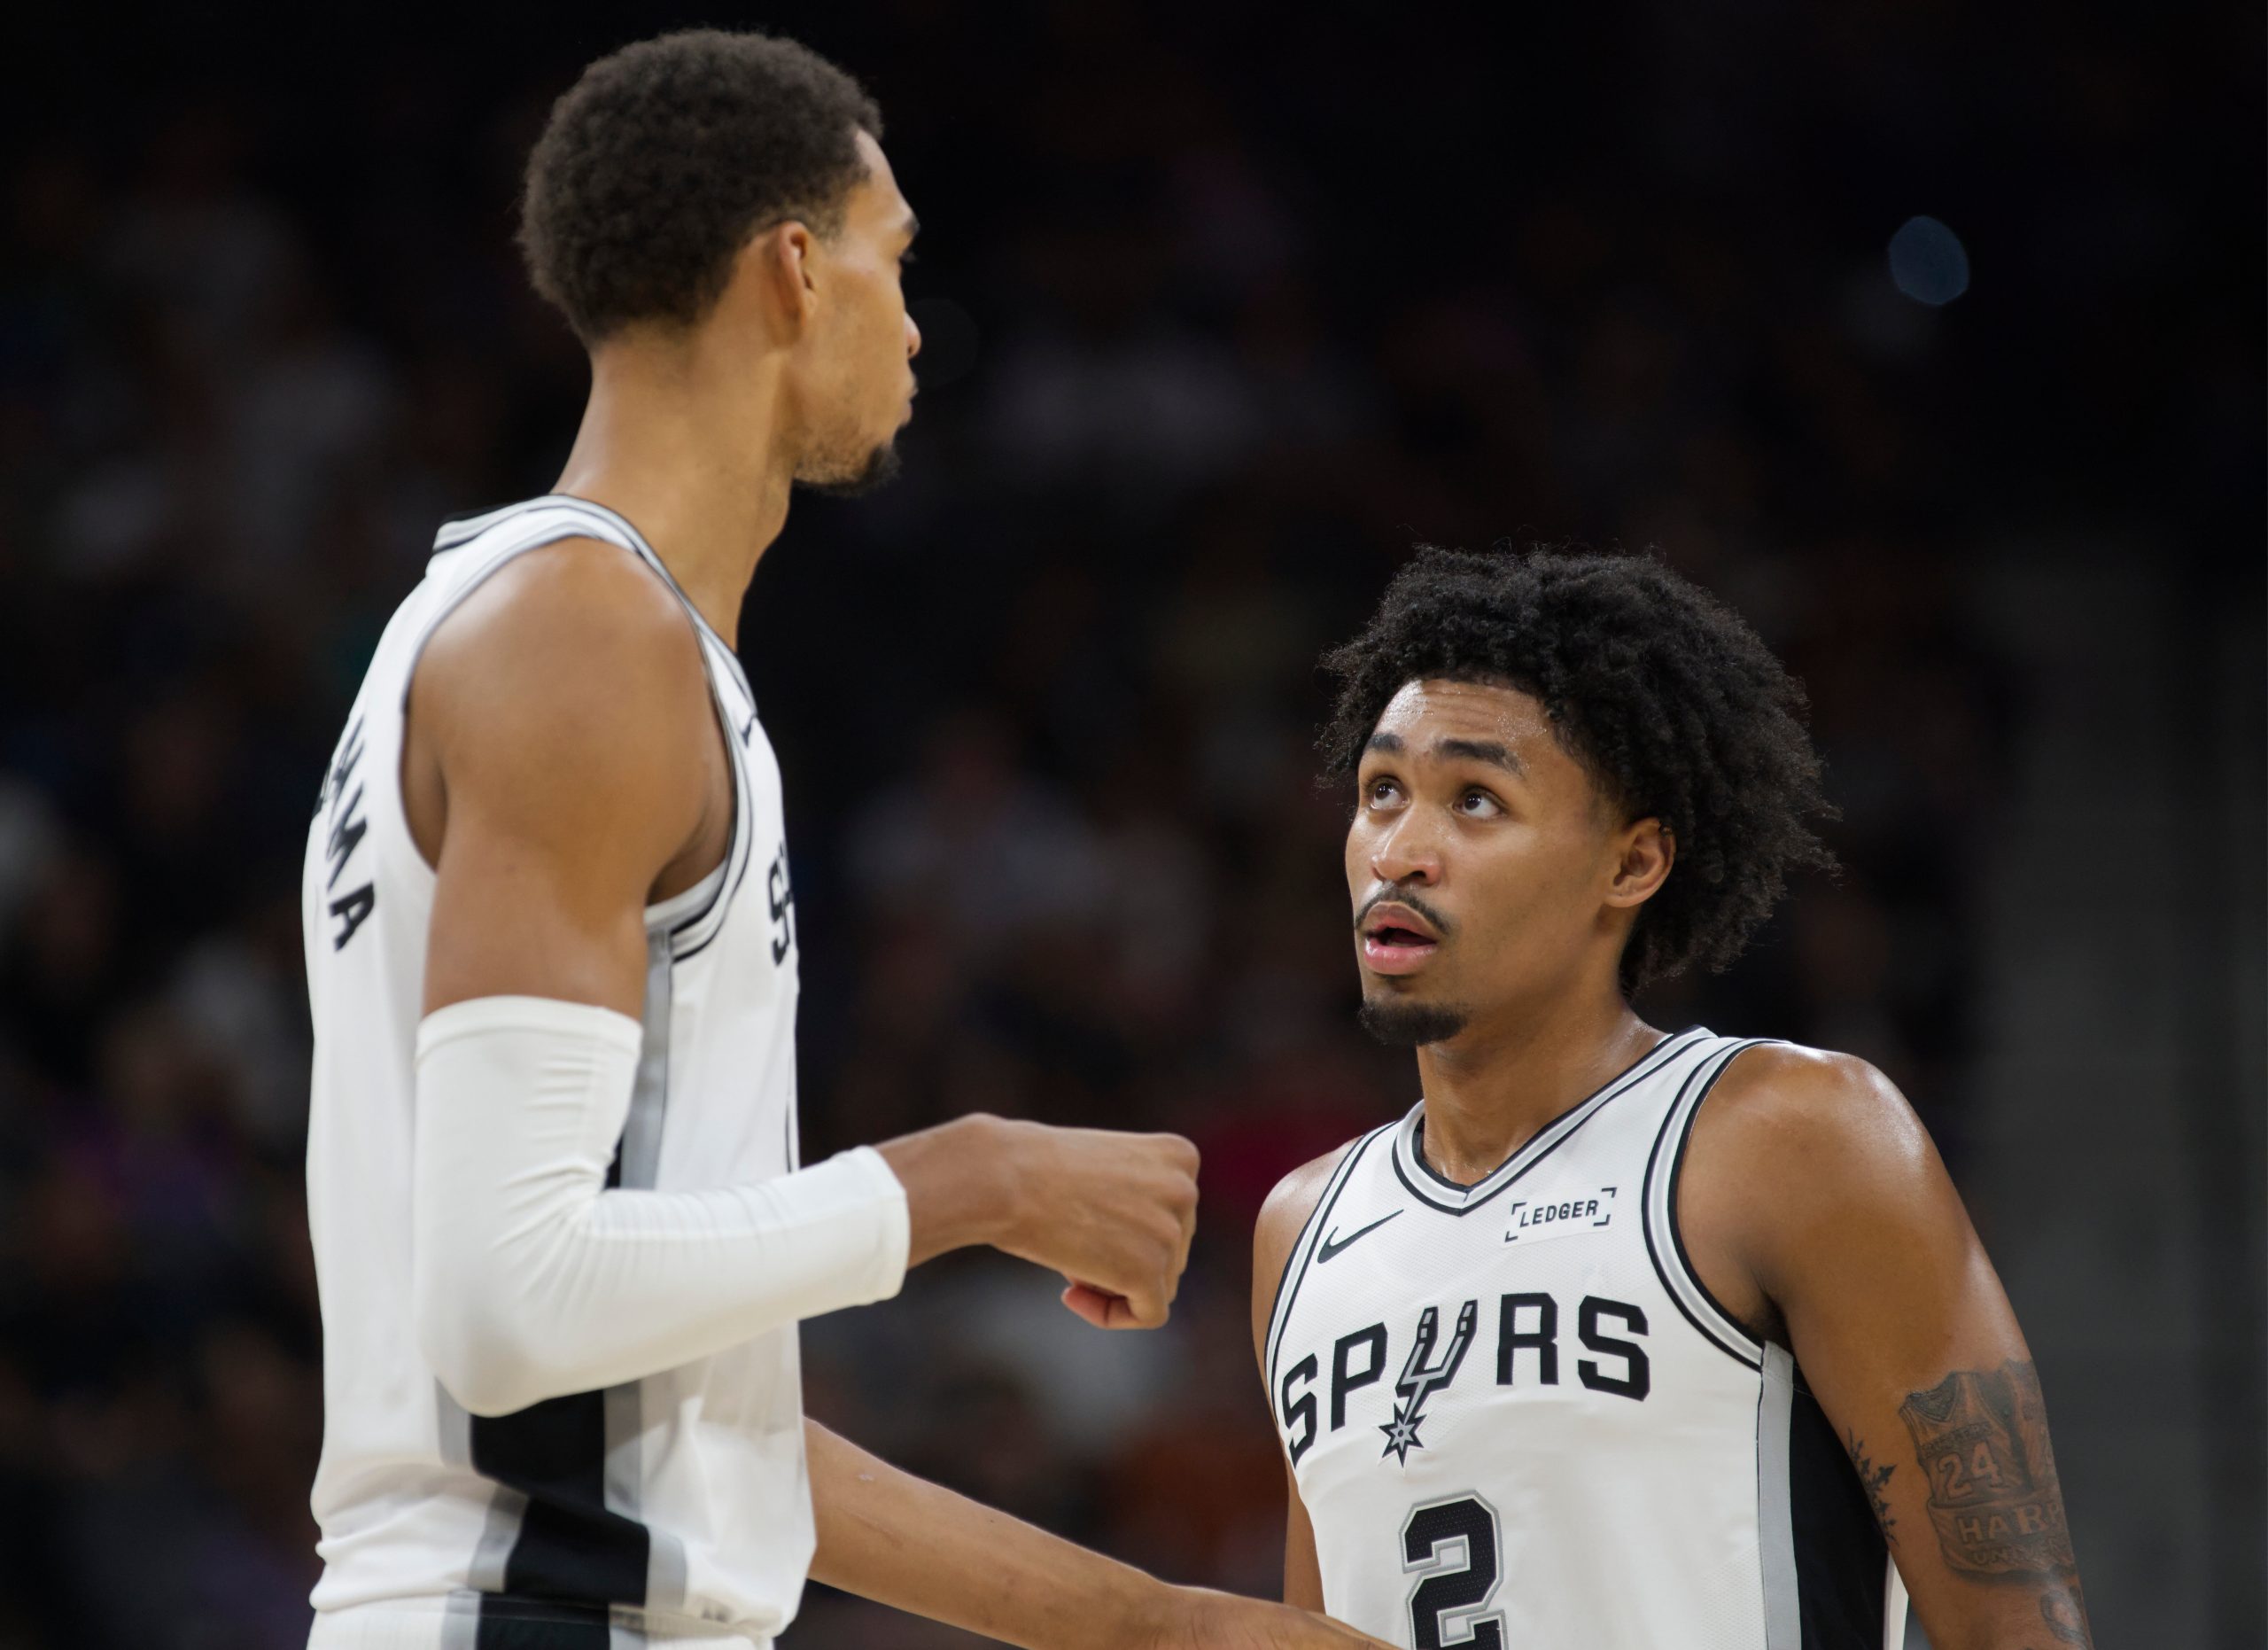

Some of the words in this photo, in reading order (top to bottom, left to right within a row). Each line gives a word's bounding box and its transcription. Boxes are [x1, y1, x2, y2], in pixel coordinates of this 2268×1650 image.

[1519, 1199, 1599, 1228] LEDGER
[1282, 1293, 1651, 1470] SPURS
[1937, 1440, 2005, 1499] 24
[1399, 1489, 1510, 1650] 2
